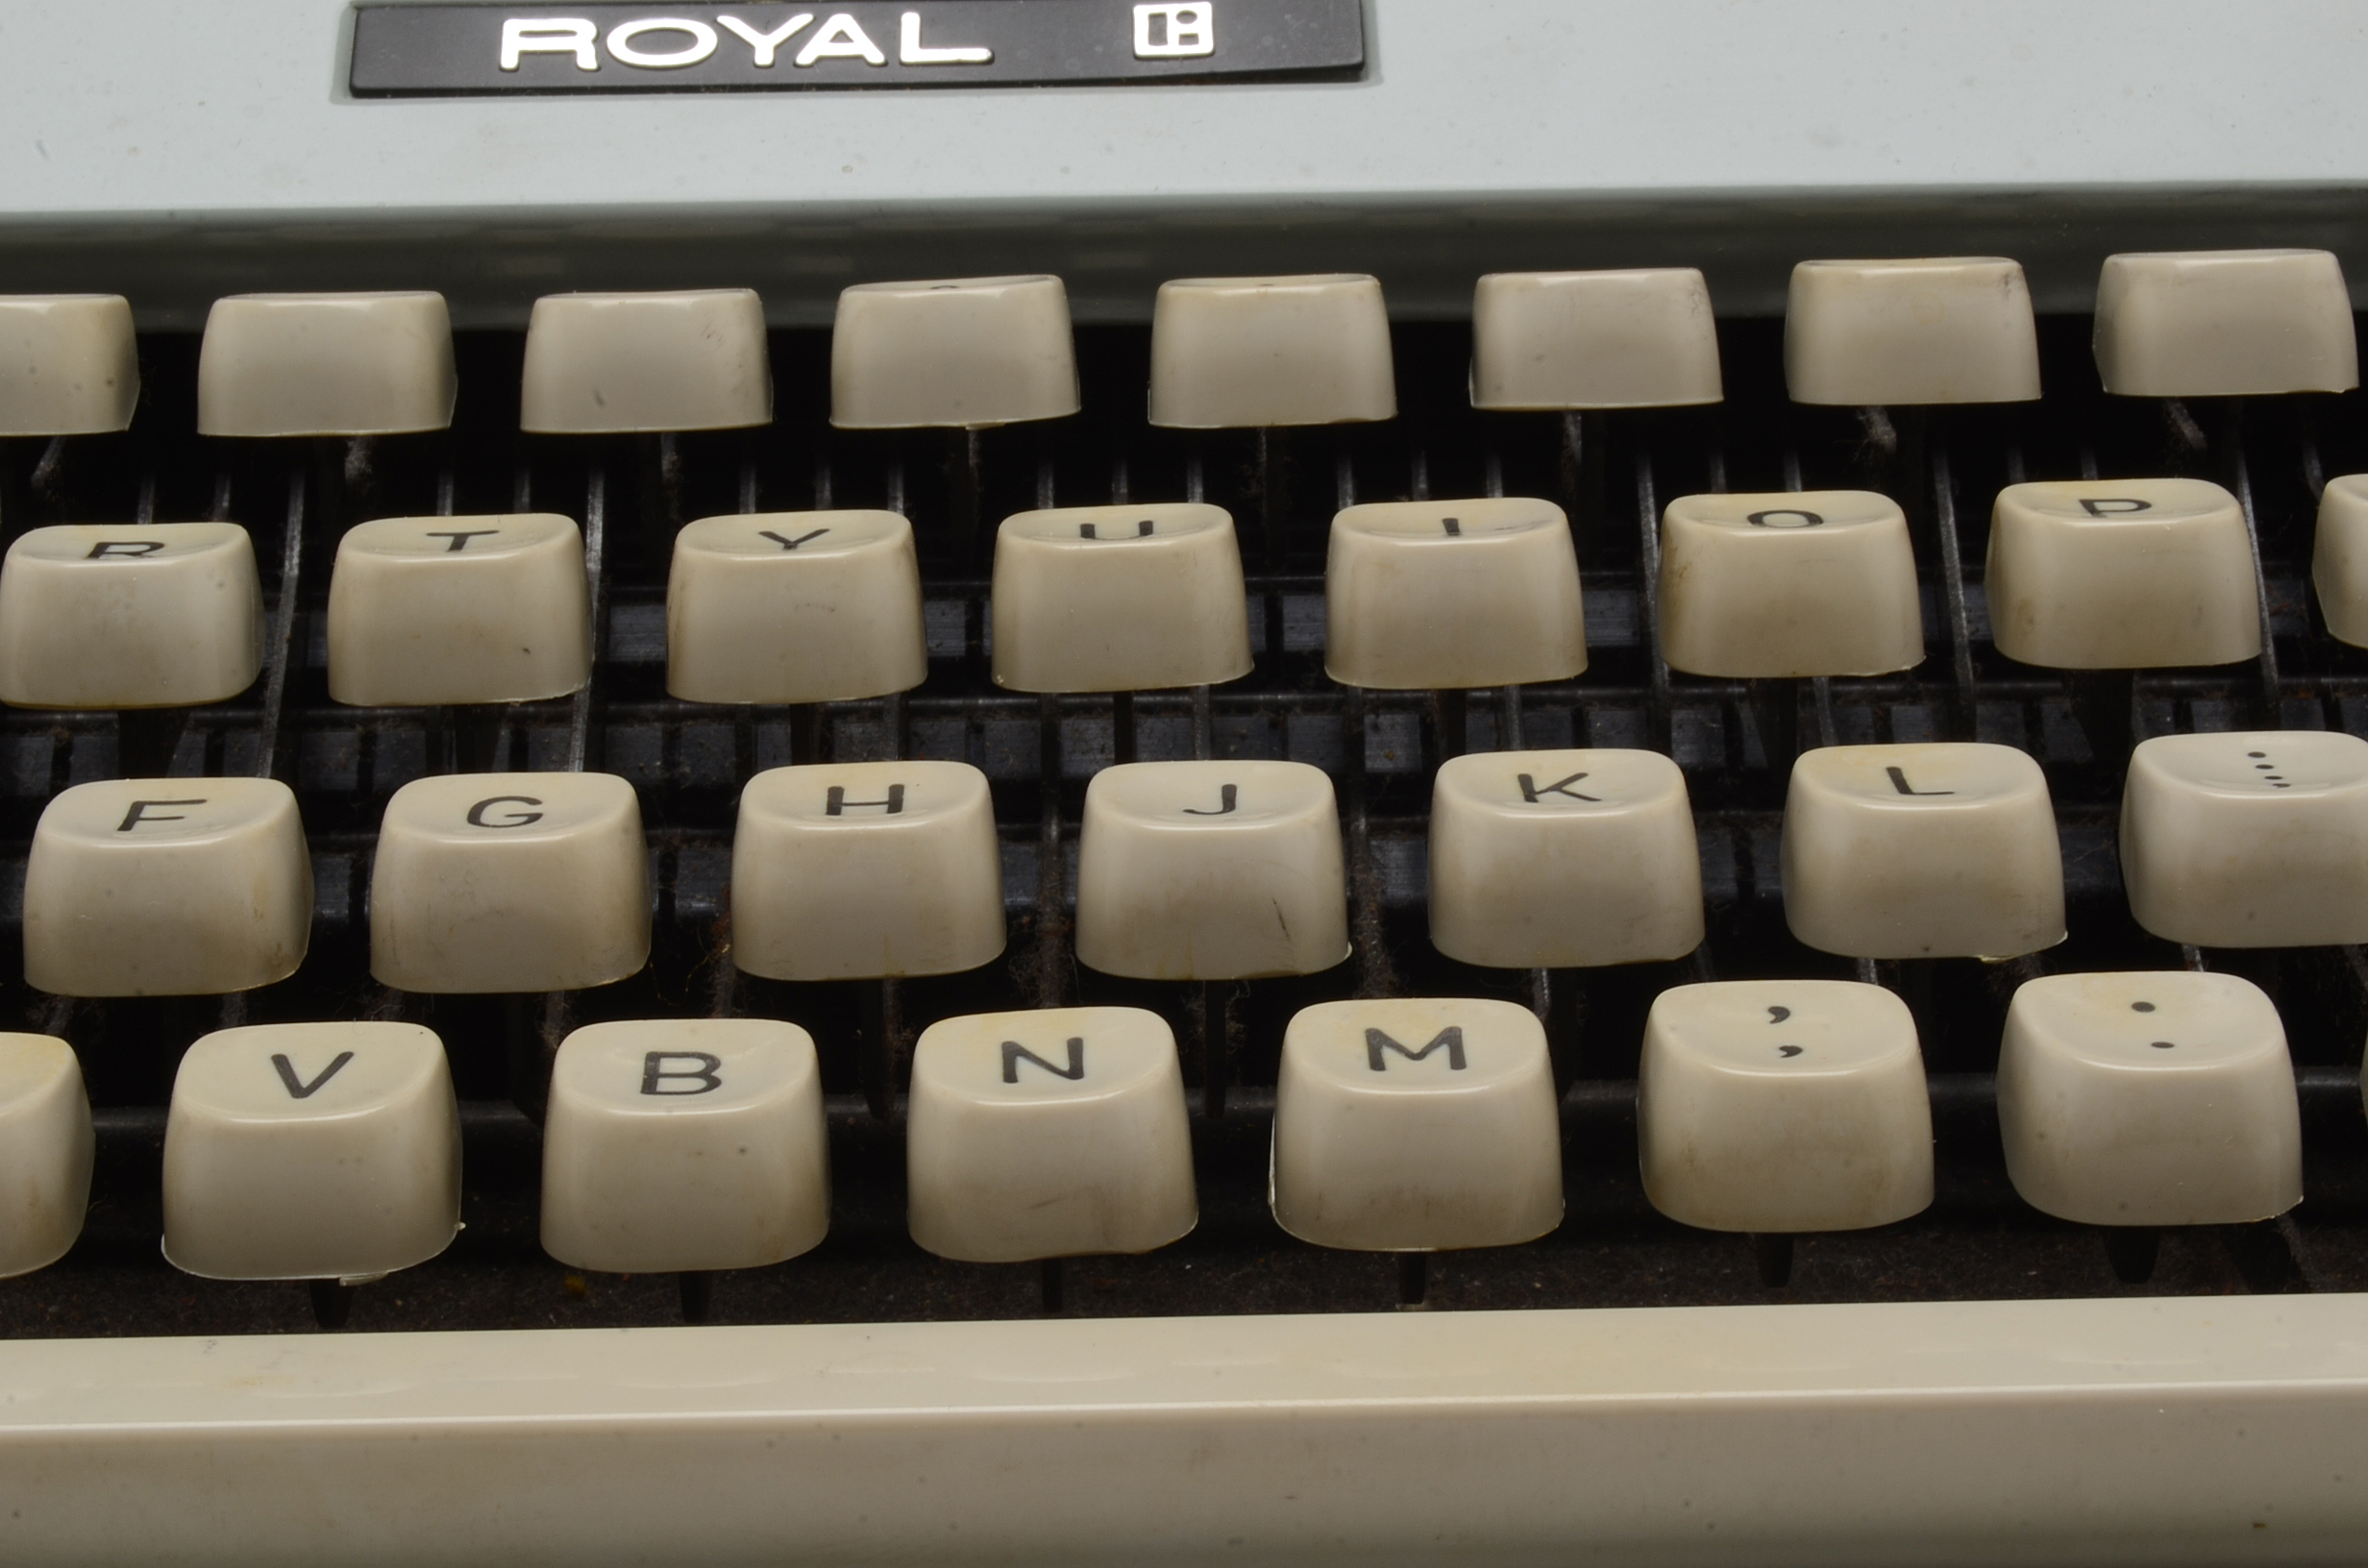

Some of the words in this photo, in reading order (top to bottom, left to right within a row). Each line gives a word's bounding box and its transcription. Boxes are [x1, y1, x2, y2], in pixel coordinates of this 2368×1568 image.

[500, 11, 993, 72] ROYAL
[1746, 509, 1824, 527] O
[2079, 499, 2153, 517] P
[427, 529, 499, 552] T
[759, 528, 829, 551] Y
[1079, 520, 1154, 541] U
[1442, 518, 1461, 537] I
[84, 541, 165, 560] R
[1517, 772, 1602, 803] K
[1886, 766, 1955, 796] L
[116, 798, 208, 832] F
[466, 796, 544, 828] G
[825, 784, 905, 817] H
[1182, 783, 1238, 816] J
[1001, 1037, 1085, 1084] N
[1365, 1026, 1468, 1072] M
[271, 1051, 355, 1099] V
[640, 1051, 722, 1096] B
